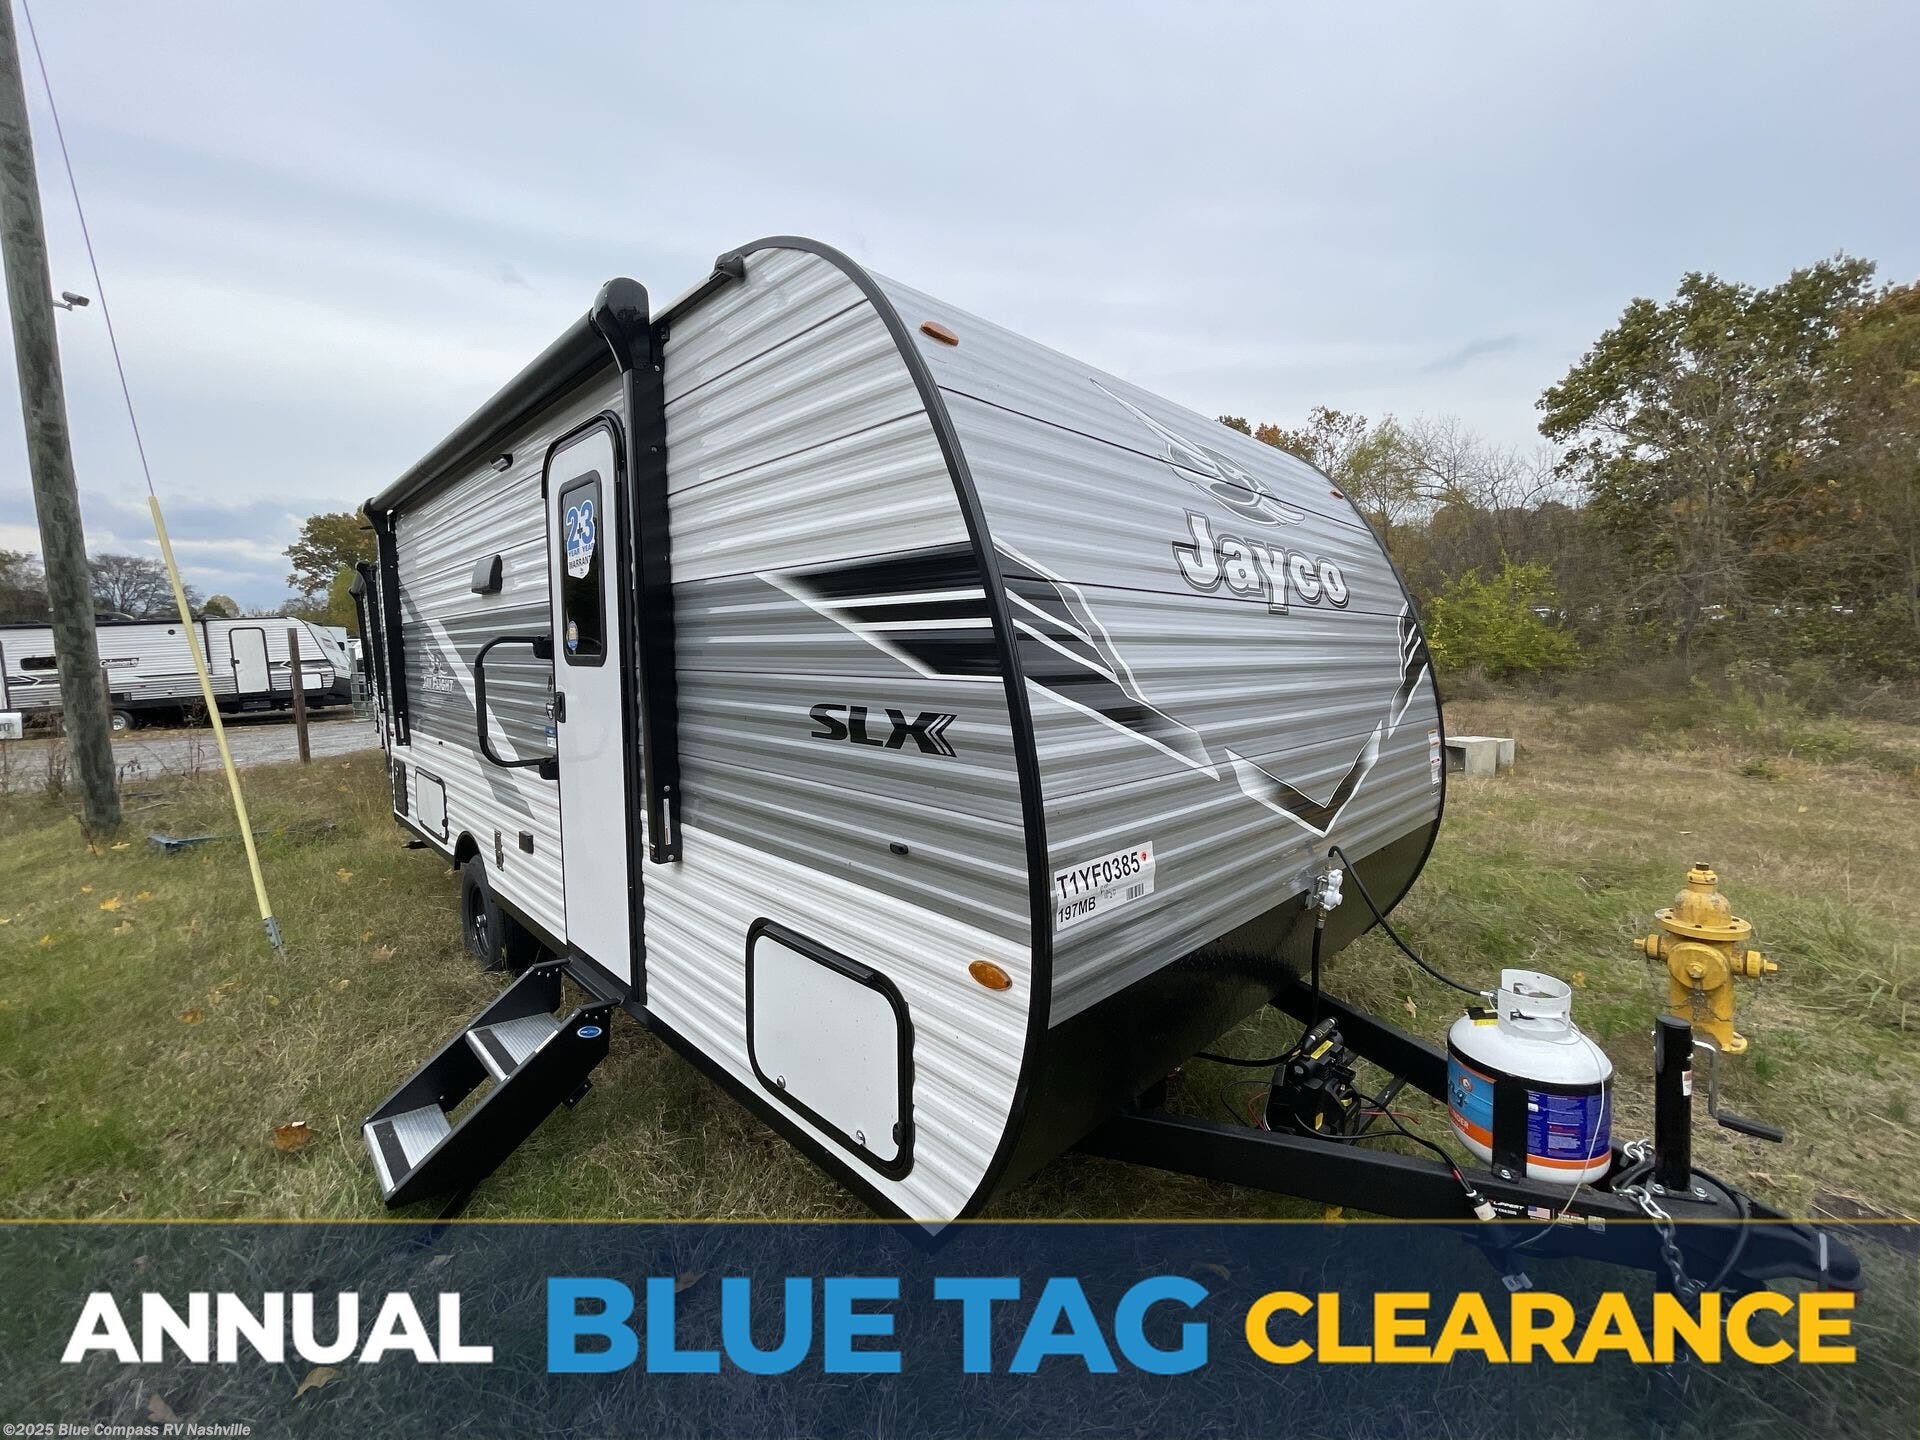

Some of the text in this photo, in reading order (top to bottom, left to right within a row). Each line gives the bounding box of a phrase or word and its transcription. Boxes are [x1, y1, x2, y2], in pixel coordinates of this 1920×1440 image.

[1172, 507, 1350, 616] Jayco
[809, 703, 957, 757] SLX
[1056, 851, 1141, 899] T1YF0385
[1058, 896, 1096, 923] 197MB
